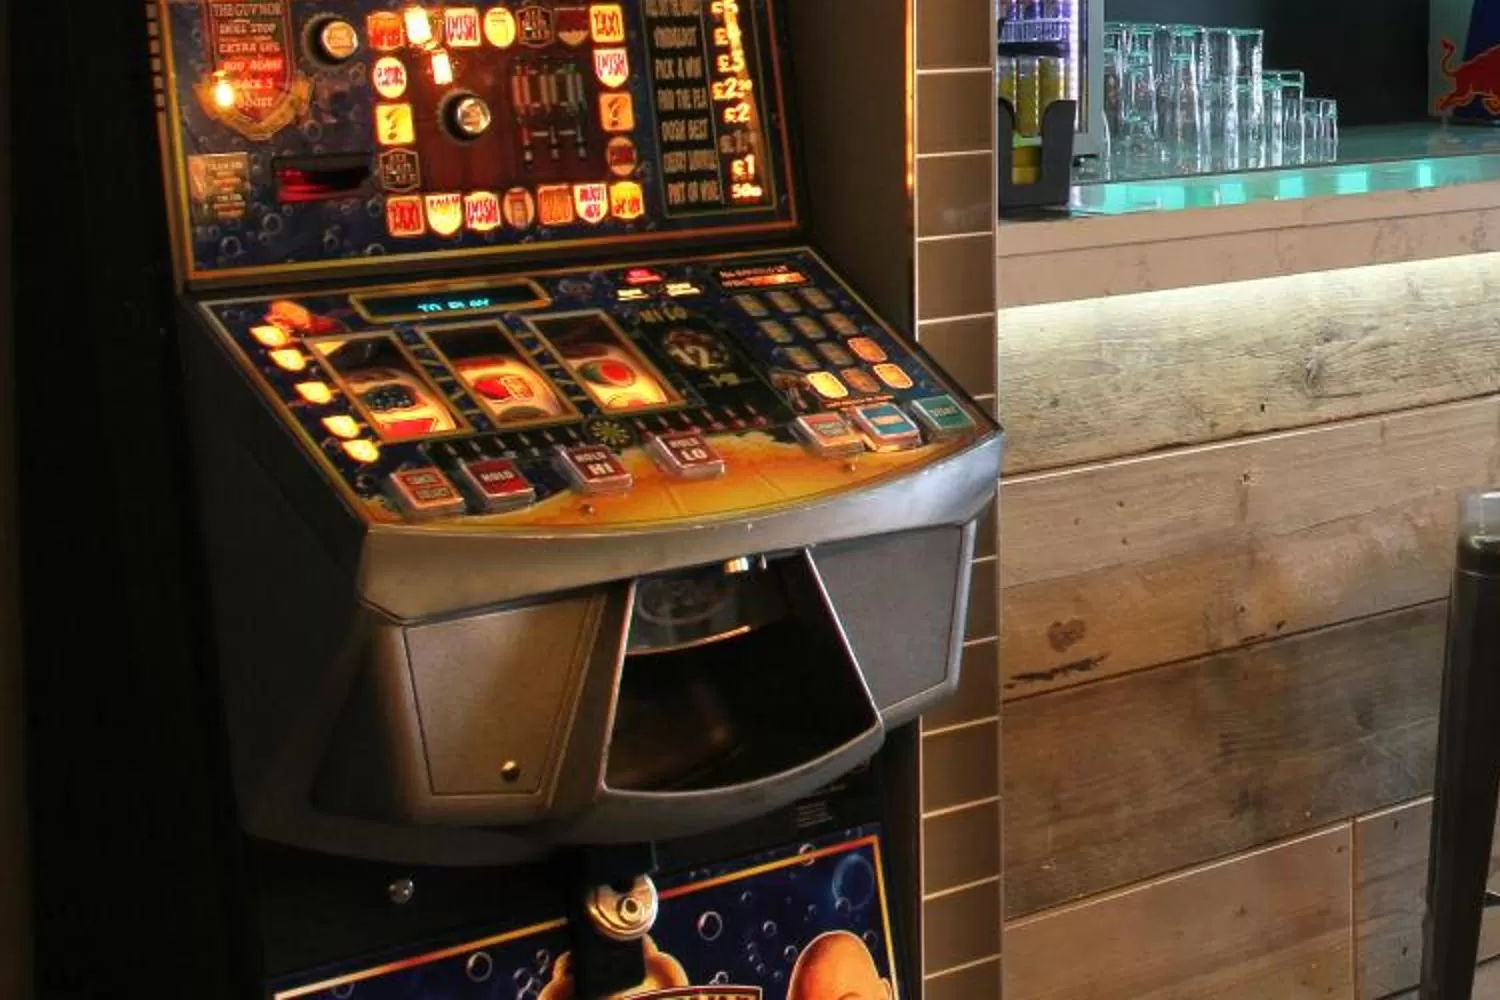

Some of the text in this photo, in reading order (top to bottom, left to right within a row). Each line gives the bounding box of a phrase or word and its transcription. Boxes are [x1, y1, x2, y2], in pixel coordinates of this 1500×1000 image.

[218, 42, 257, 54] EXTRA
[723, 102, 751, 124] £2
[730, 153, 757, 178] £1
[575, 451, 608, 464] HOLD
[682, 448, 708, 463] LO
[480, 469, 515, 483] HOLD
[588, 462, 615, 476] HI
